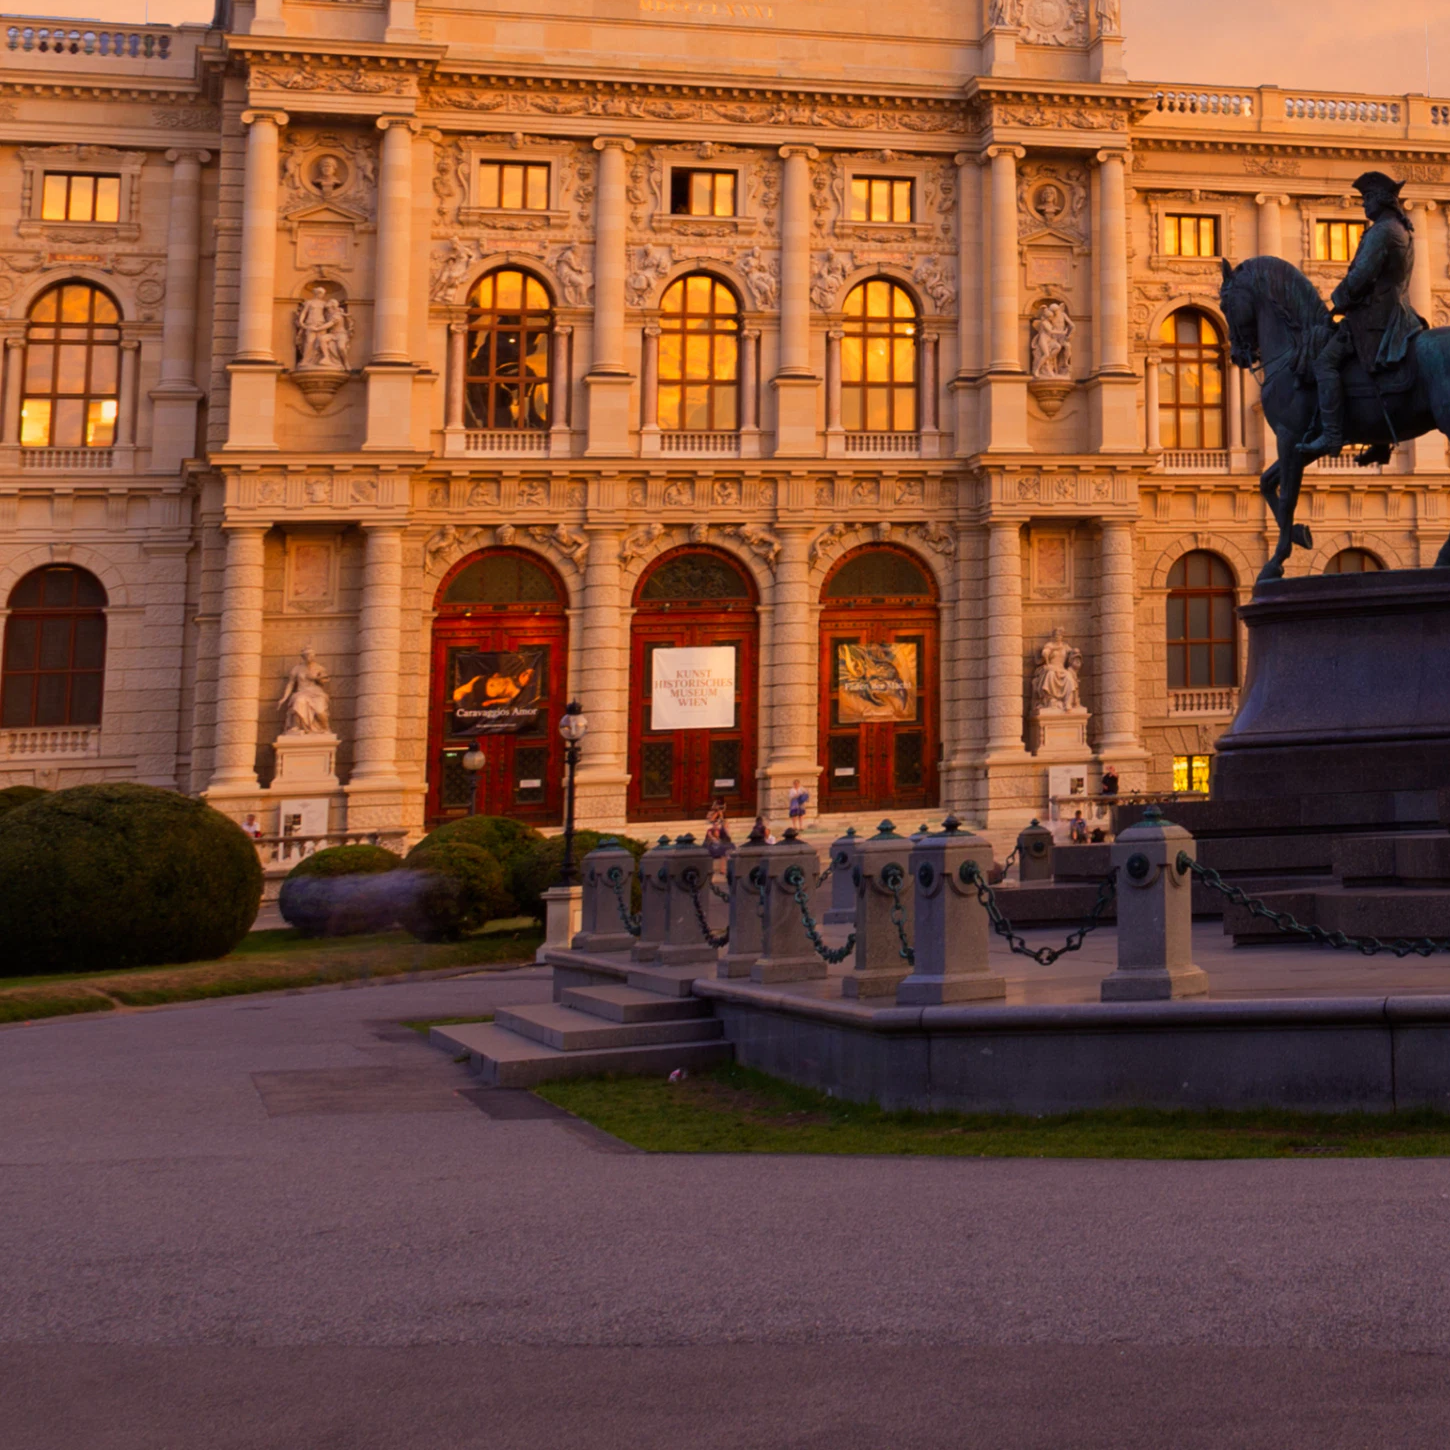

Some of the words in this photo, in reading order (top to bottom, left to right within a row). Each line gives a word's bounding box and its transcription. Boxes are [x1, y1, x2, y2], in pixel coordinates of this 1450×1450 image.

[676, 669, 711, 679] KUNST
[655, 678, 733, 689] HISTORISCHES
[671, 688, 717, 698] MUSEUM
[678, 698, 708, 707] WIEN
[456, 708, 509, 718] Caravaggios
[512, 707, 538, 716] Amor
